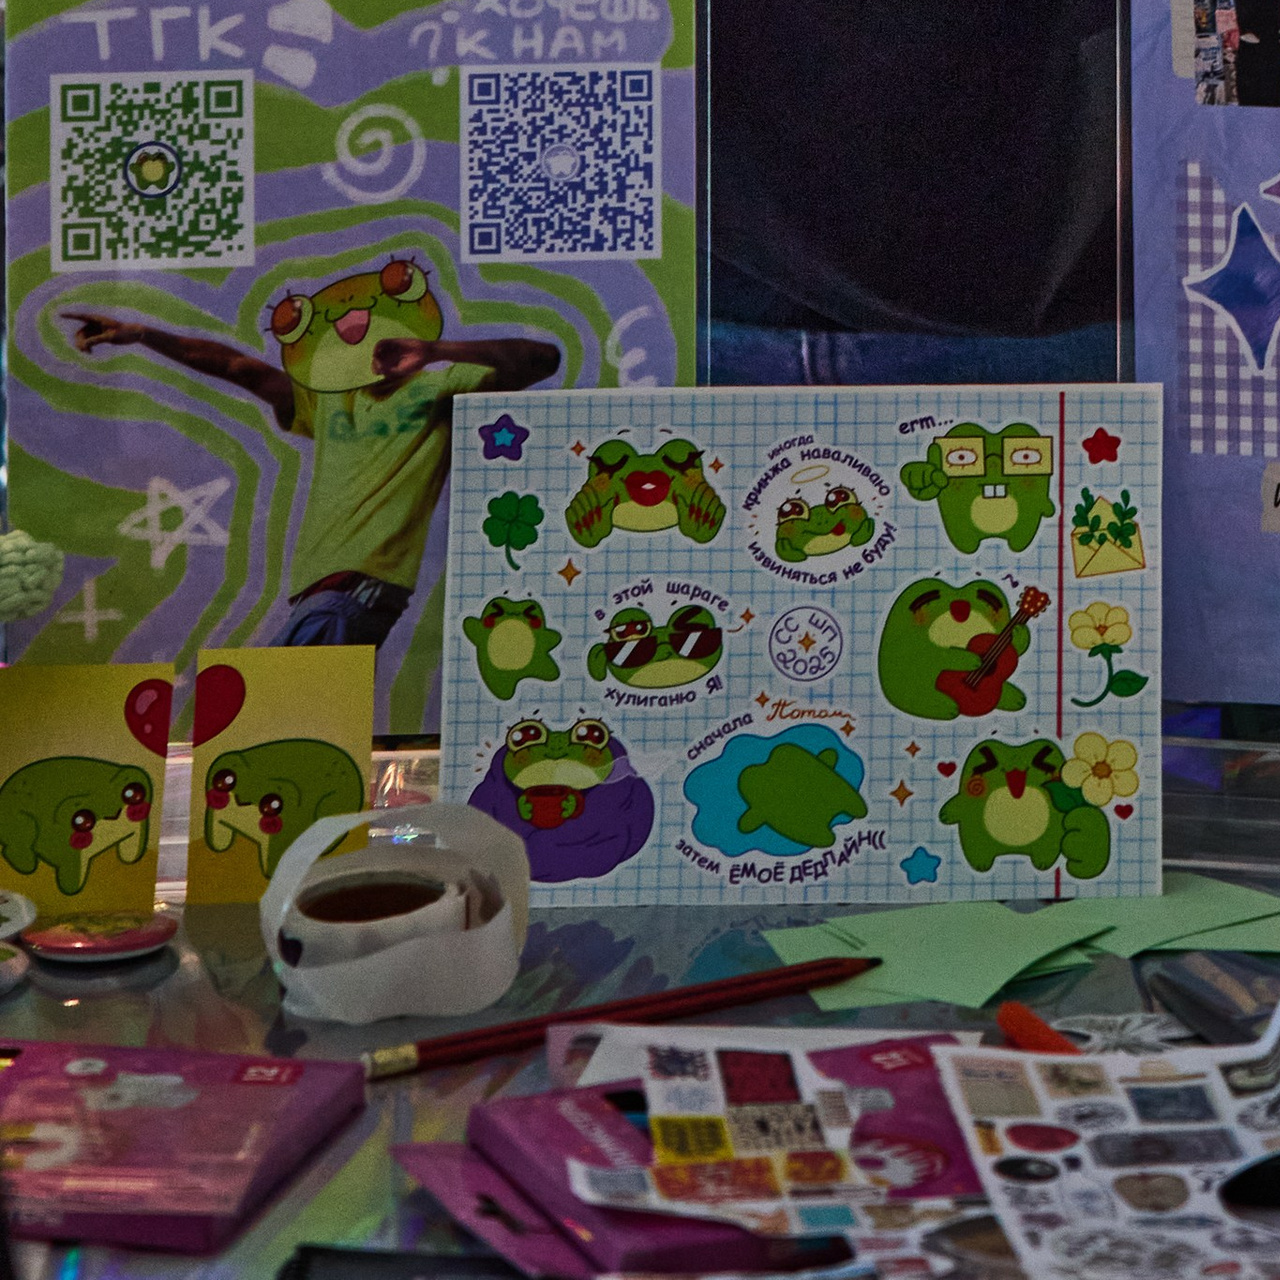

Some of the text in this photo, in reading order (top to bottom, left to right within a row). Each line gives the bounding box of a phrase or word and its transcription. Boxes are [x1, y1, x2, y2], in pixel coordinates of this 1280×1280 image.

[59, 4, 246, 62] ТГК
[767, 435, 814, 460] иногда
[742, 448, 890, 511] кринжа наваливаю
[748, 521, 897, 585] извиняться не буду!
[594, 578, 729, 621] в этой шараге
[808, 612, 838, 643] ШП
[776, 646, 836, 675] 2025
[604, 687, 697, 707] хулиганю
[686, 712, 754, 761] сначала
[674, 839, 722, 874] затем
